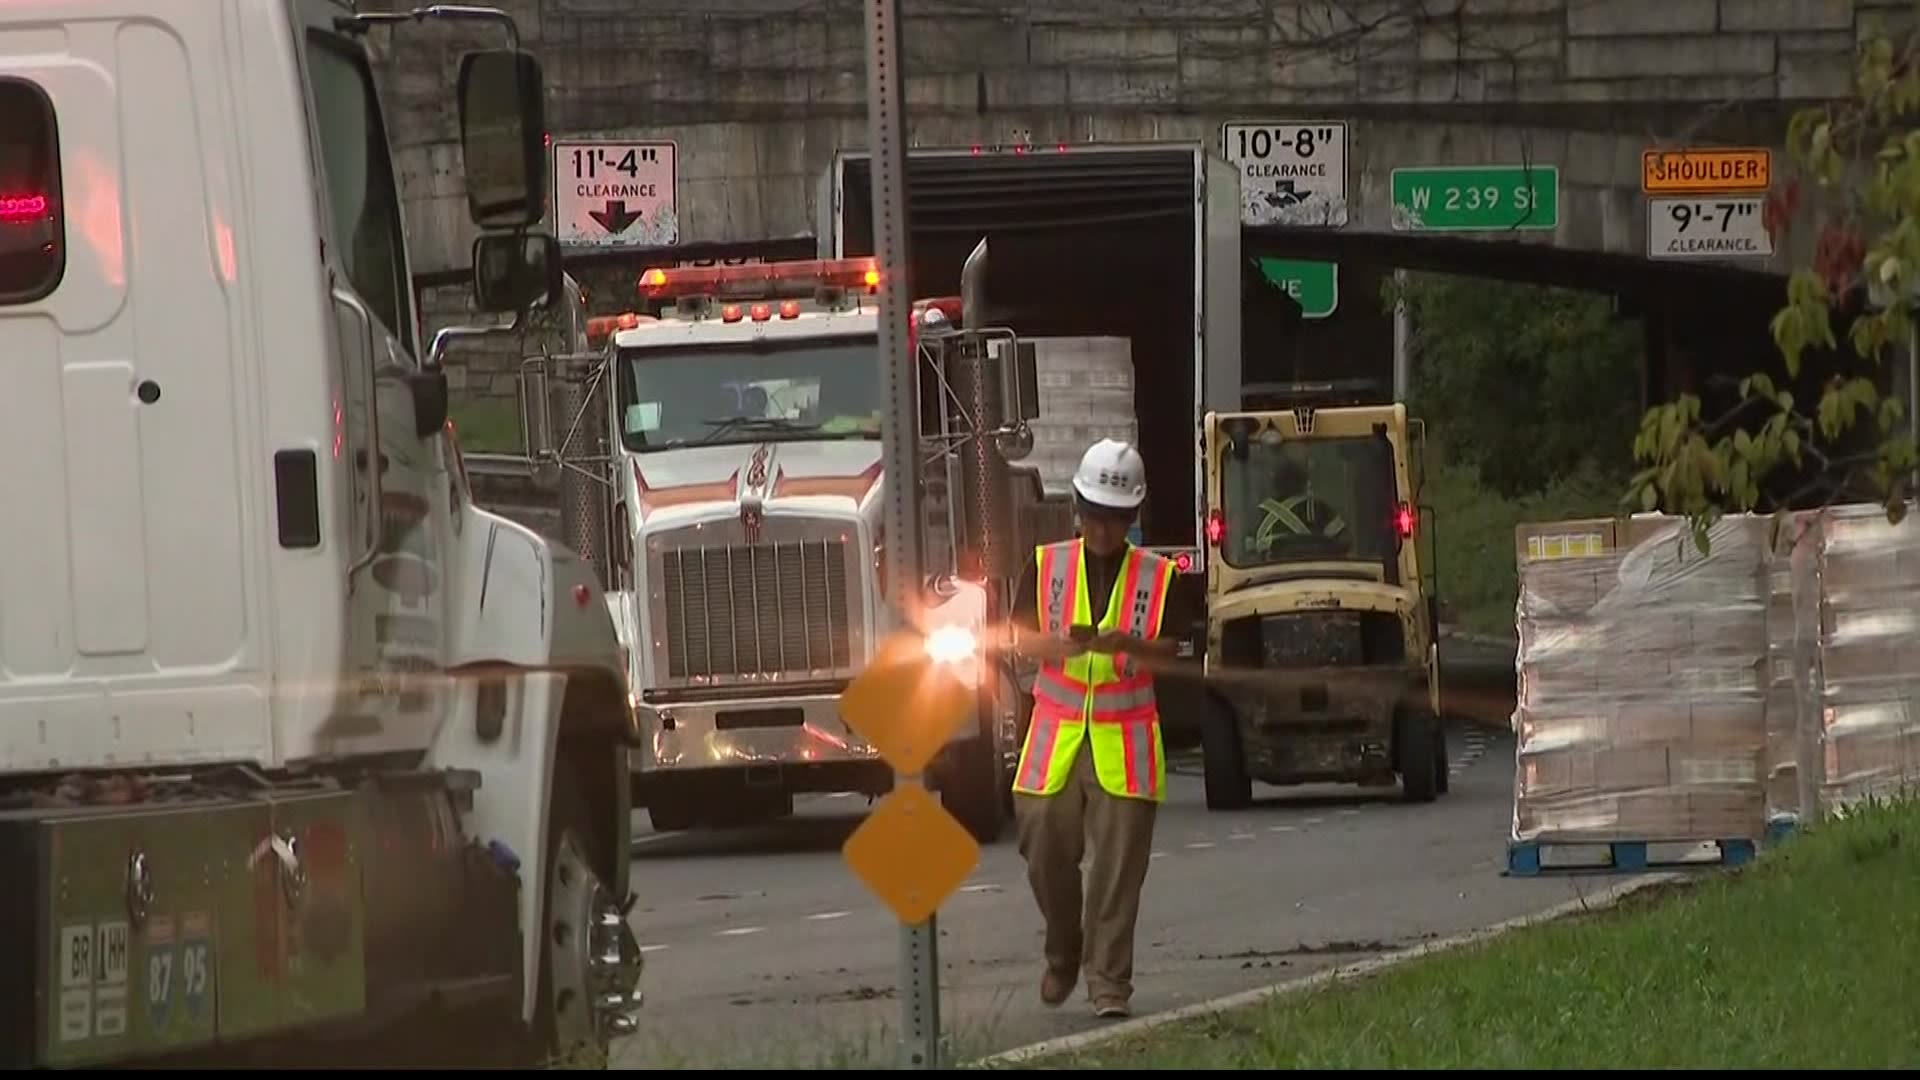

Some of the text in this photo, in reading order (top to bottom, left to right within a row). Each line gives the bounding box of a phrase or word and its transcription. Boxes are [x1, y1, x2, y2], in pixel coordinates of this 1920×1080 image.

[1238, 128, 1332, 158] 10'-8"
[573, 148, 656, 178] 11'-4"
[1247, 163, 1325, 177] CLEARANCE
[1655, 160, 1758, 180] SHOULDER
[577, 184, 656, 197] CLEARANCE
[1411, 186, 1430, 210] W
[1445, 186, 1499, 210] 239
[1671, 203, 1752, 233] 9'-7"
[1671, 238, 1753, 252] CLEARANCE
[150, 953, 173, 1003] 87
[184, 946, 206, 995] 95
